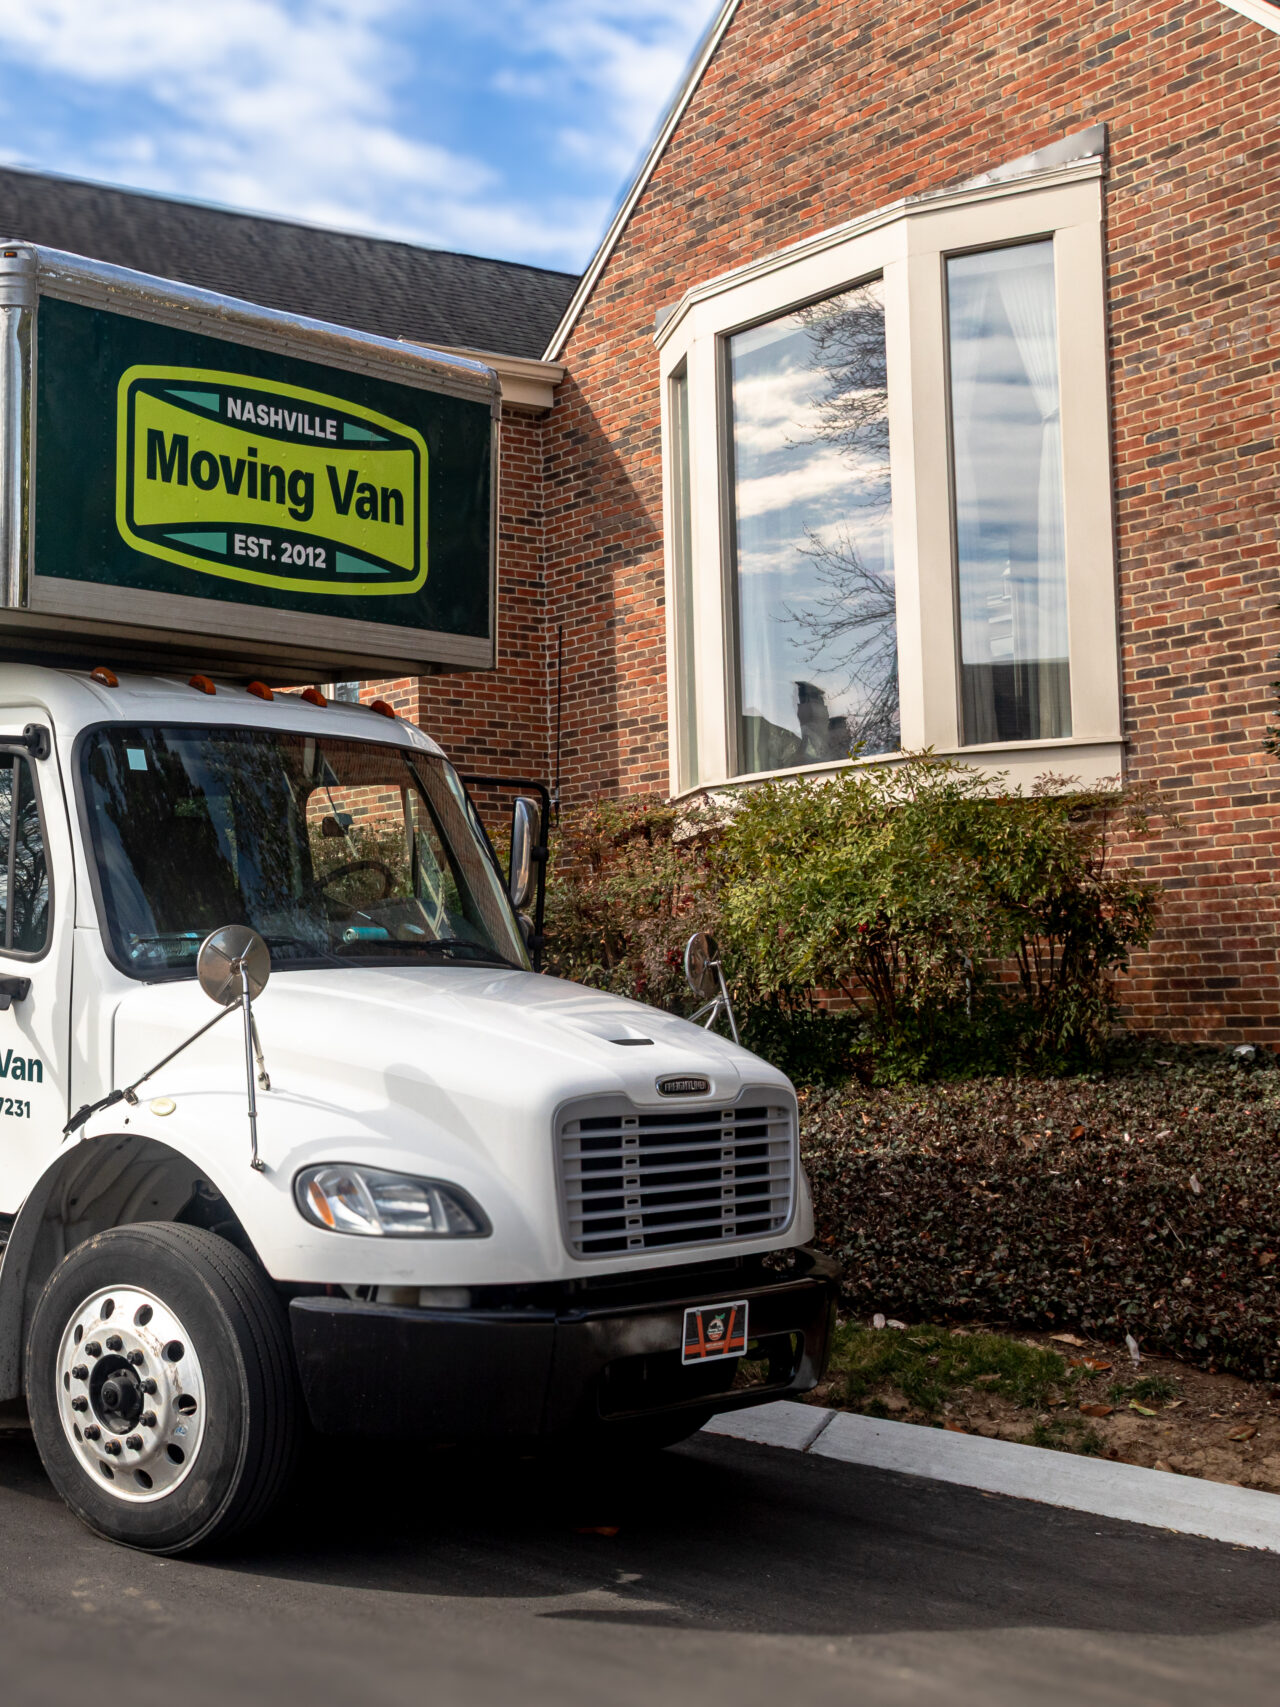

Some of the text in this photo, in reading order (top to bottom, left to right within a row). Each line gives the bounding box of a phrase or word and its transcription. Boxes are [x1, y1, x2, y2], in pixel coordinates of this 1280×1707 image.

[227, 397, 337, 440] NASHVILLE
[146, 428, 404, 526] Moving Van
[233, 533, 327, 568] EST. 2012
